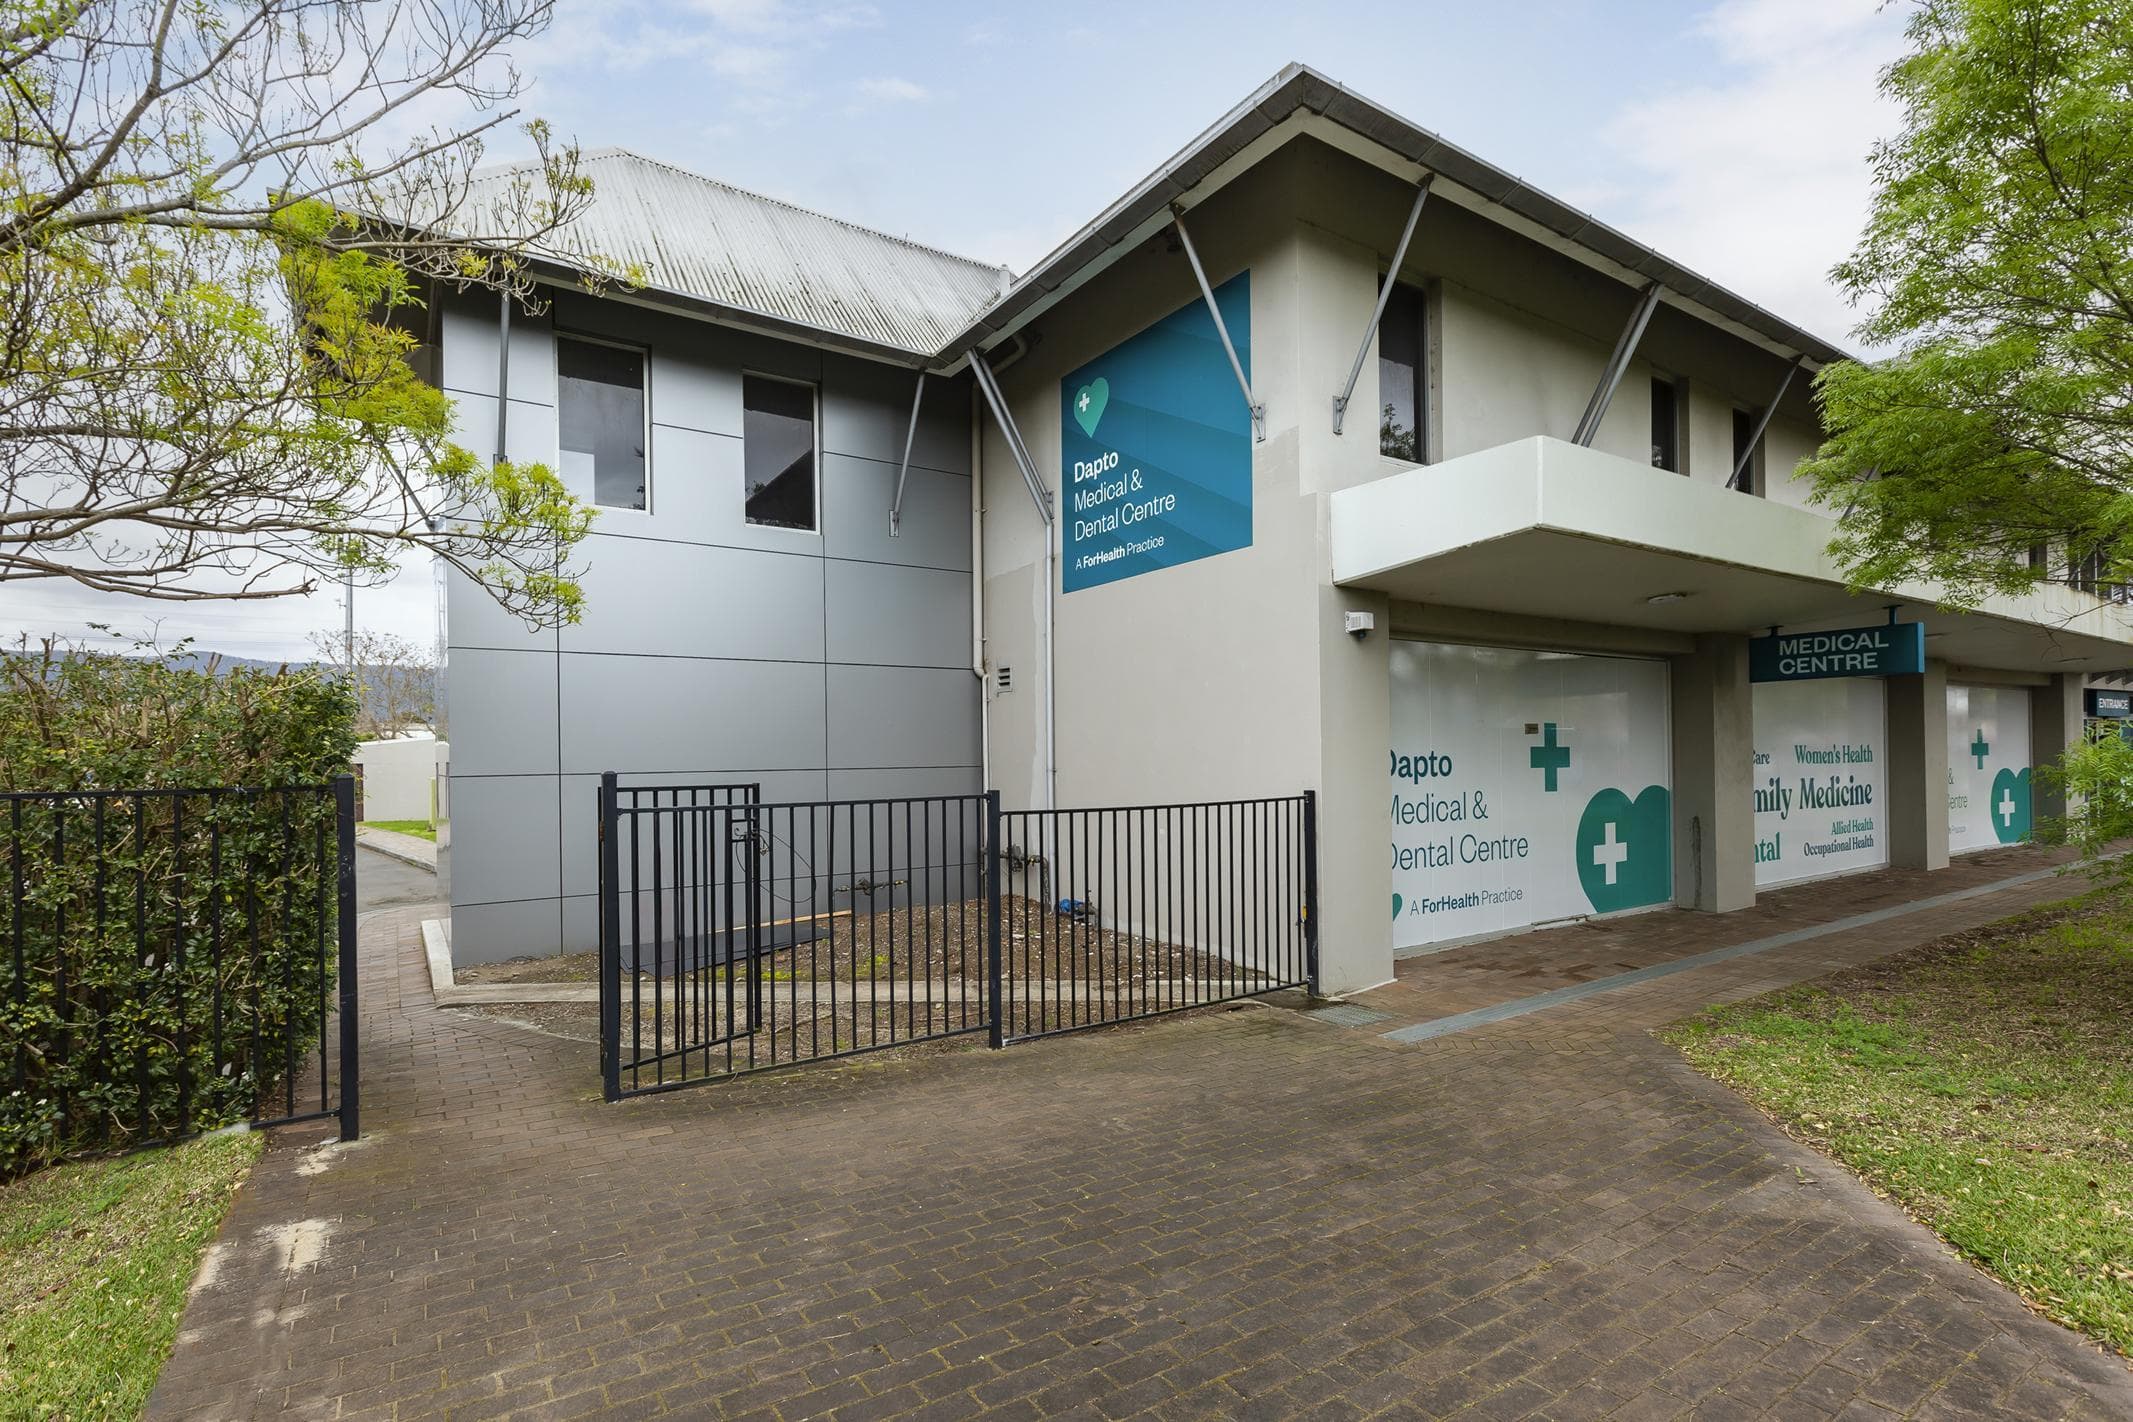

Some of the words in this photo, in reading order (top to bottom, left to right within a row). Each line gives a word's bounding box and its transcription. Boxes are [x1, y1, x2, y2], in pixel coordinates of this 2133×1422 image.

[1074, 451, 1118, 483] Dapto
[1074, 473, 1127, 512] Medical
[1130, 469, 1143, 491] &
[1075, 507, 1118, 542] Dental
[1122, 494, 1175, 525] Centre
[1075, 558, 1083, 570] A
[1083, 545, 1126, 569] ForHealth
[1126, 535, 1165, 556] Practice
[1779, 631, 1889, 656] MEDICAL
[1778, 652, 1879, 675] CENTRE
[2098, 697, 2129, 710] ENTRANCE
[1794, 744, 1841, 764] Women's
[1843, 744, 1873, 763] Health
[1472, 790, 1488, 820] &
[1799, 775, 1873, 810] Medicine
[1948, 793, 1968, 809] entre
[1831, 821, 1851, 836] Allied
[1852, 817, 1874, 833] Health
[1460, 834, 1529, 864] Centre
[1803, 837, 1851, 858] Occupational
[1852, 834, 1874, 850] Health
[1410, 900, 1420, 916] A
[1422, 892, 1480, 914] ForHealth
[1481, 887, 1523, 905] Practice
